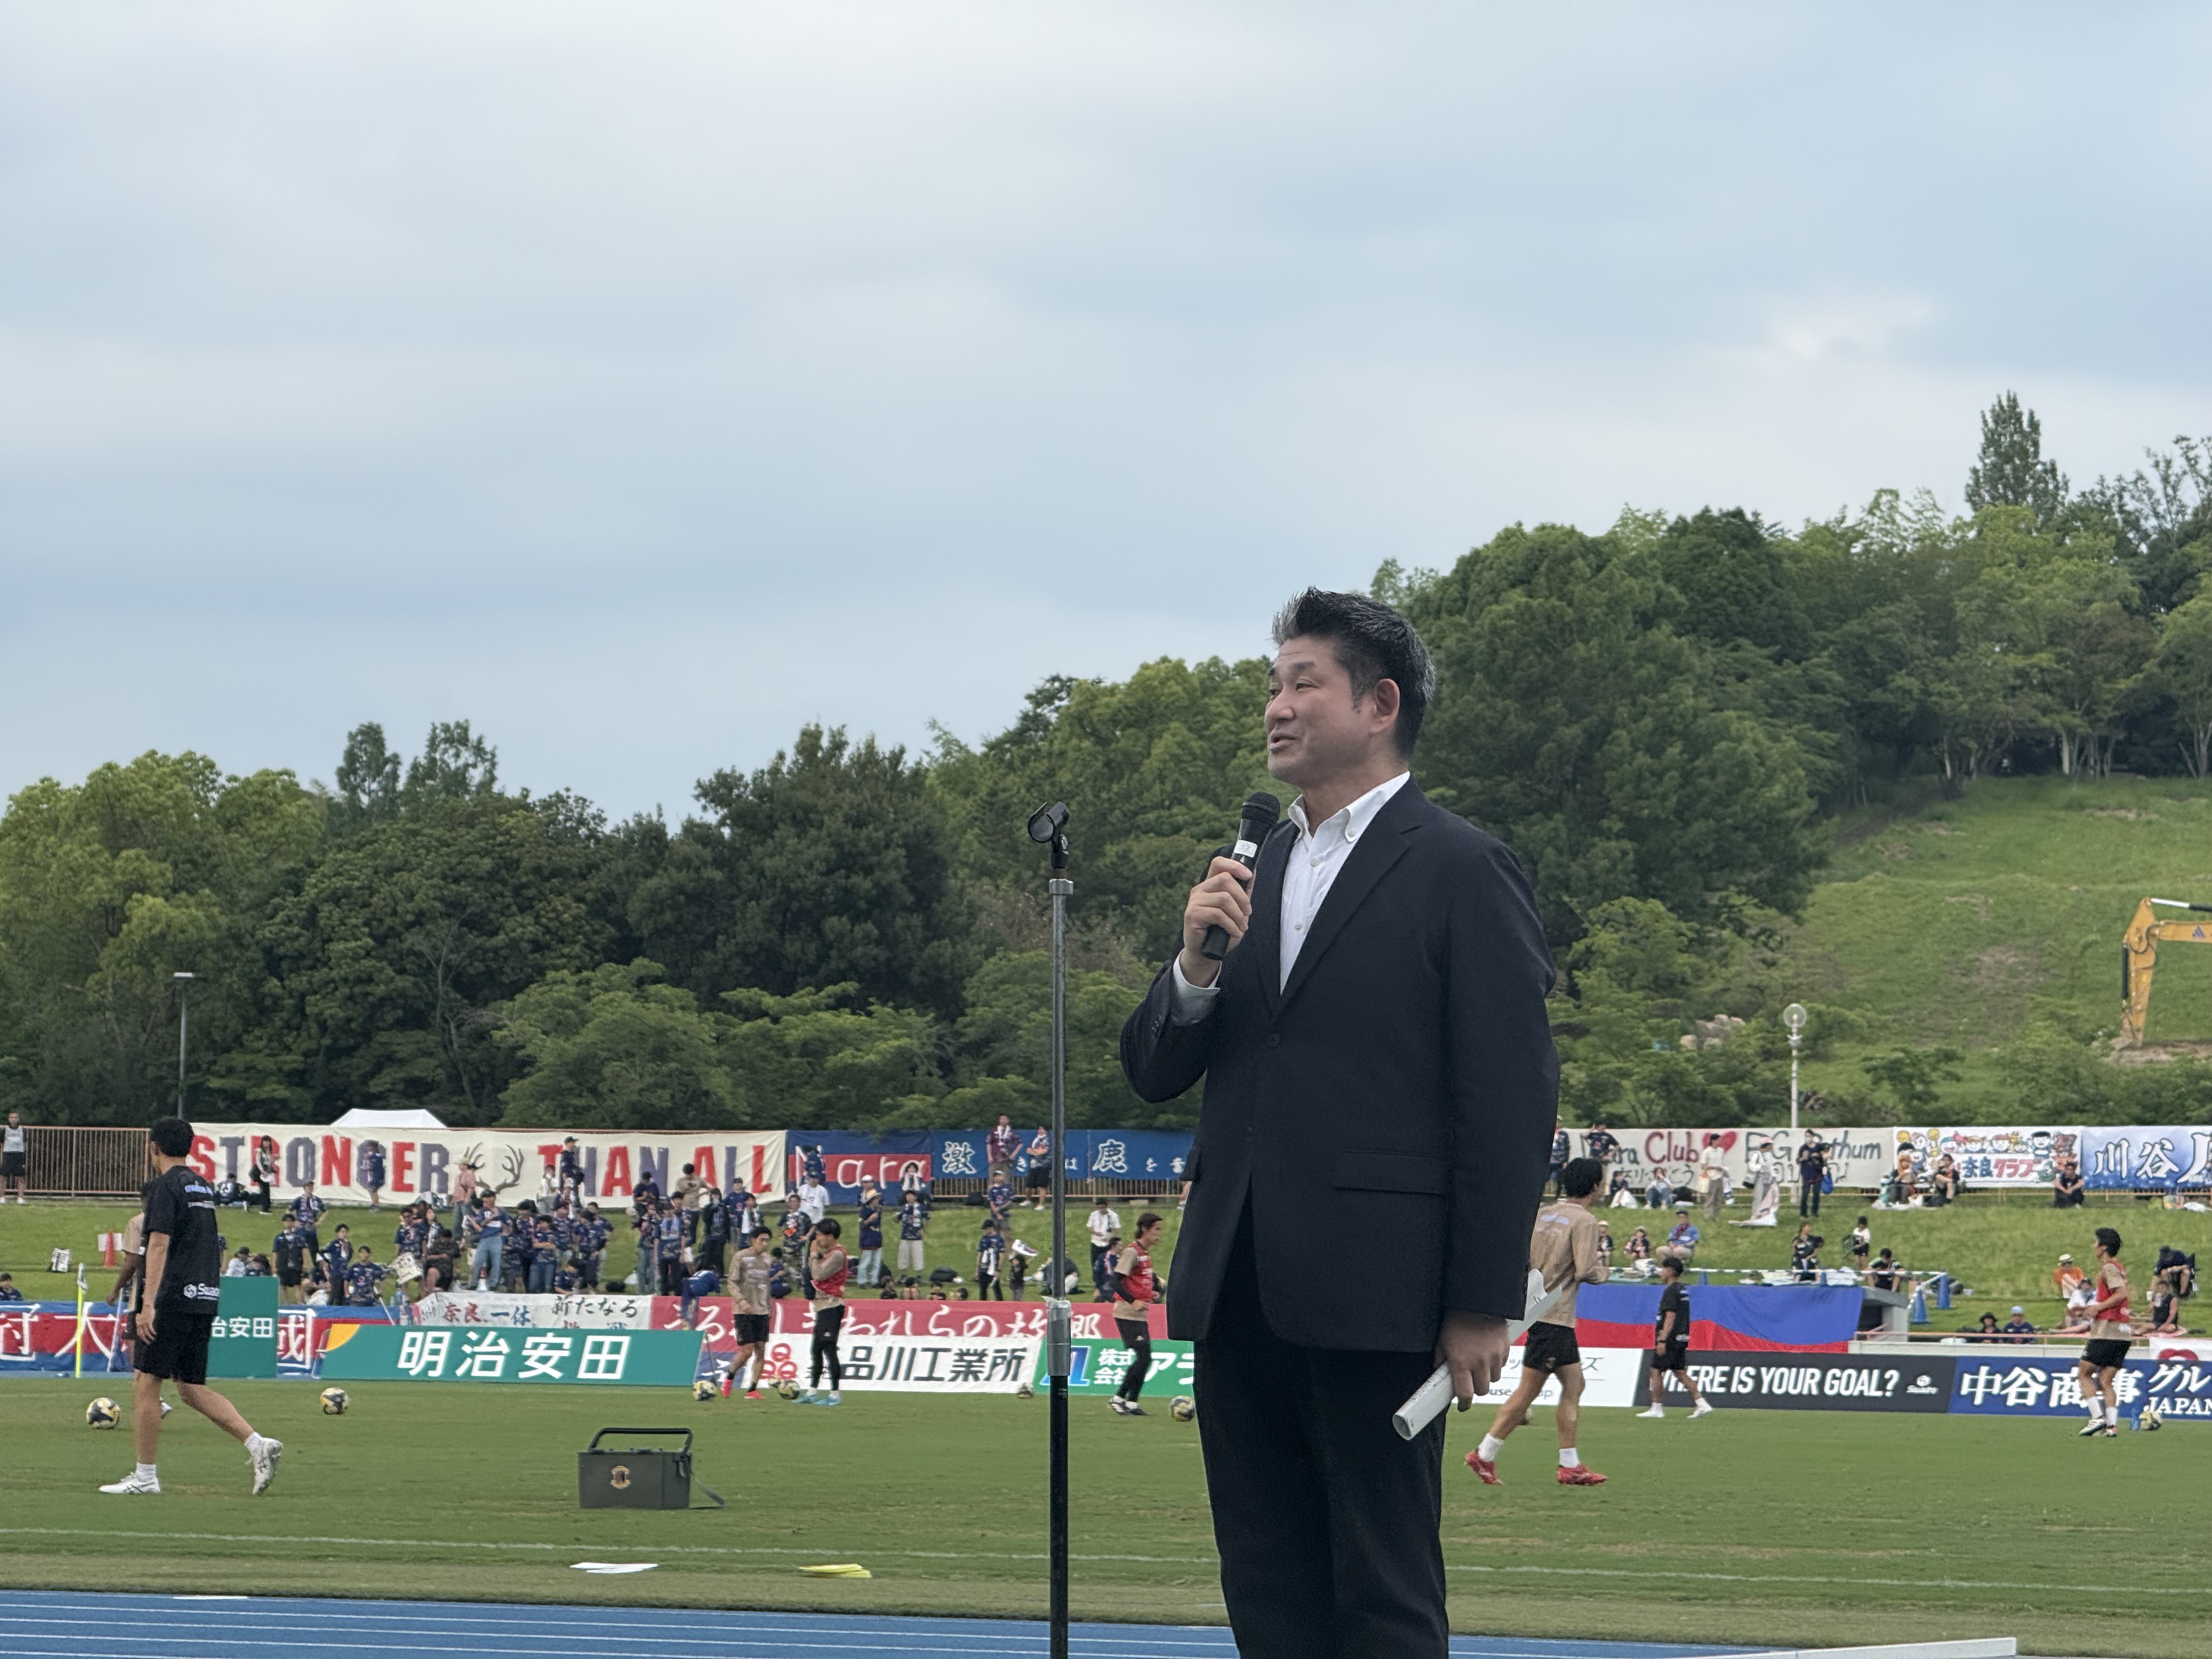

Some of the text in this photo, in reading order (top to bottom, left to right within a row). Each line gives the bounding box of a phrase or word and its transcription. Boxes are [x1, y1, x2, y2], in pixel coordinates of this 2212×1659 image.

[1645, 1131, 1699, 1164] Club
[397, 1330, 631, 1380] 明治安田
[1730, 1367, 1756, 1393] IS
[1760, 1367, 1821, 1396] YOUR
[1824, 1368, 1900, 1397] GOAL?
